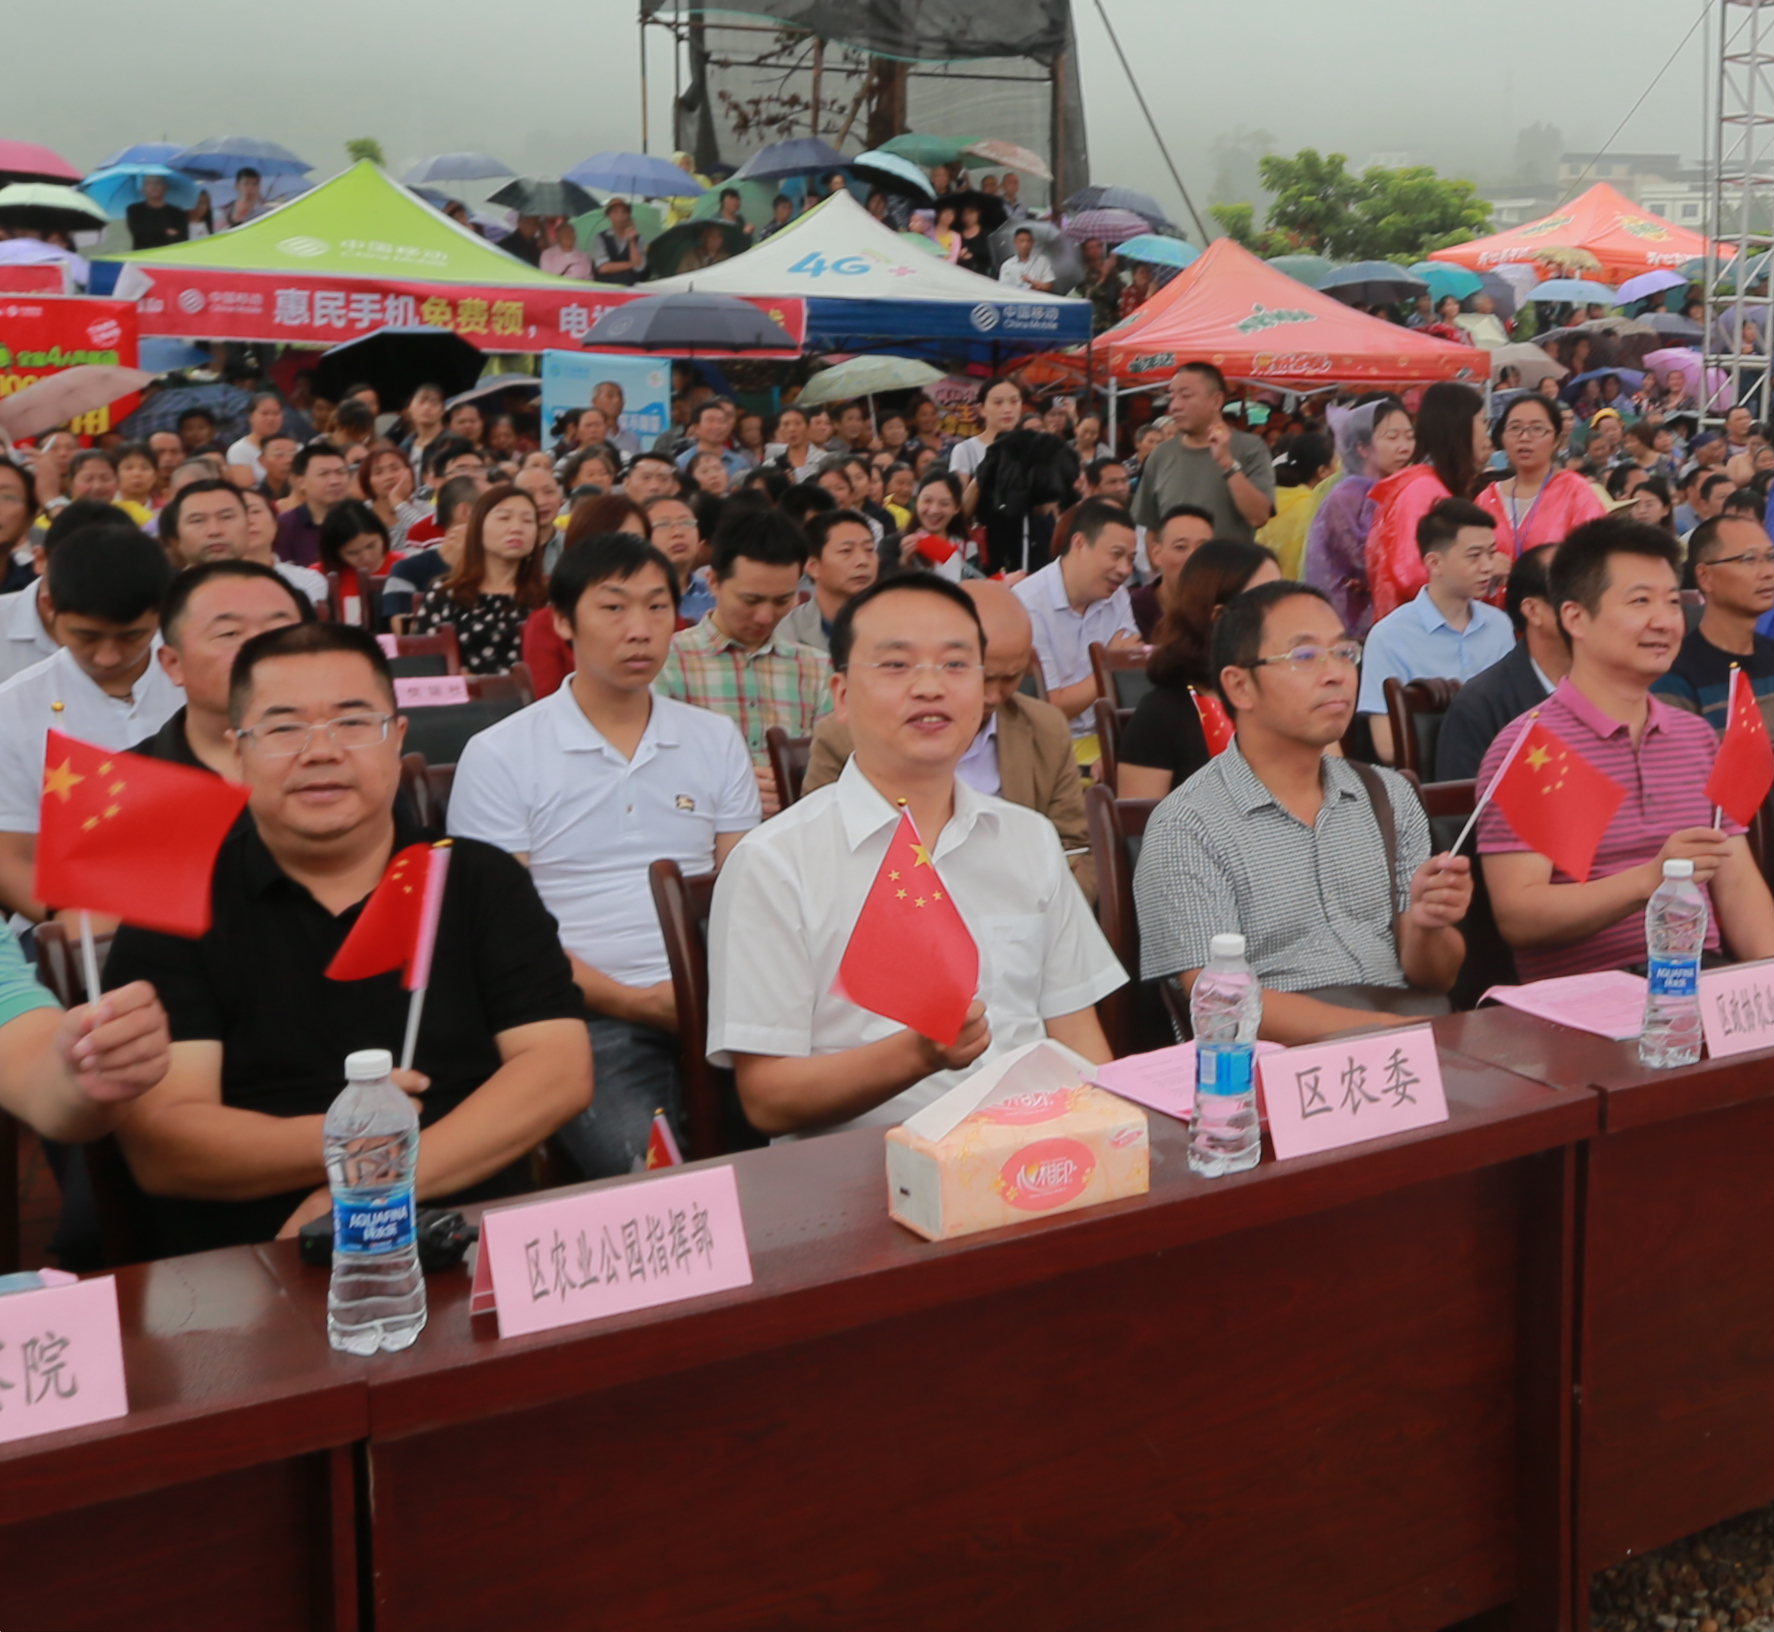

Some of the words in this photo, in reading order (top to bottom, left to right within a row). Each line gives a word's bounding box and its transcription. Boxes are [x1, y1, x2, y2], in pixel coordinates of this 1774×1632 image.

[1003, 304, 1059, 321] 中国移动
[1295, 1047, 1422, 1120] 区农委
[348, 1203, 409, 1230] AQUAFINA
[524, 1201, 715, 1304] 区农业公园指挥部
